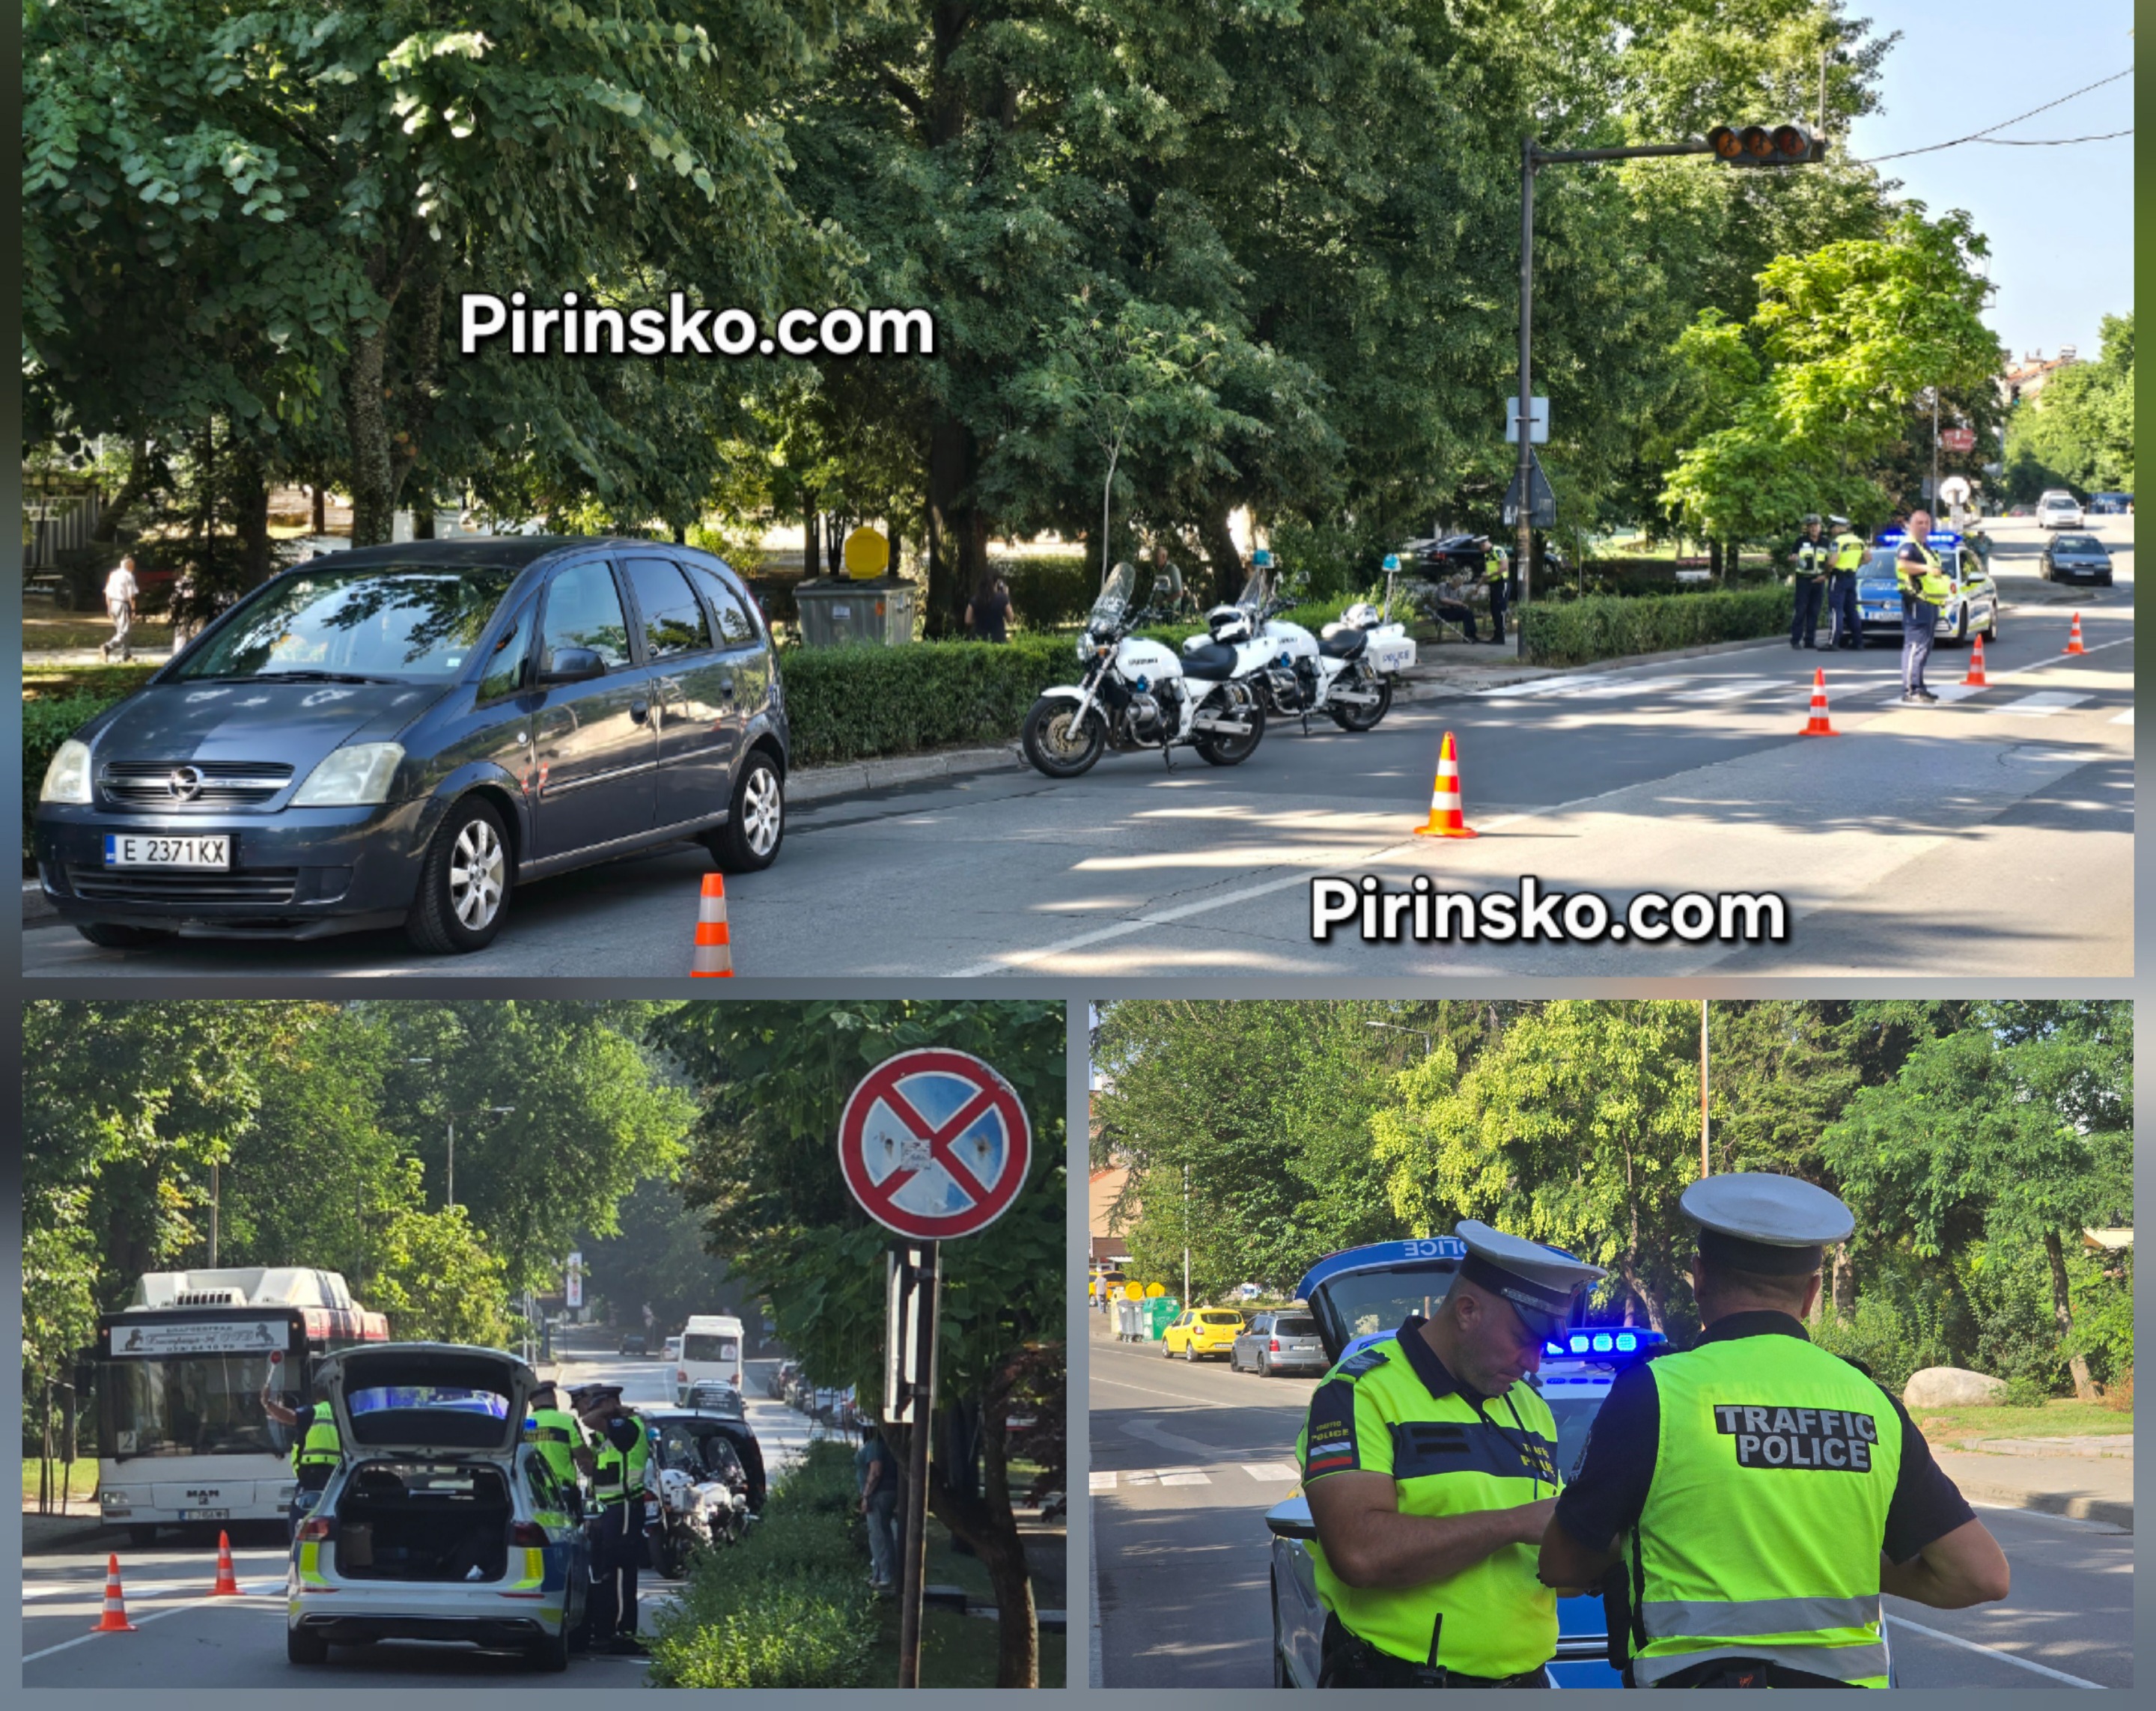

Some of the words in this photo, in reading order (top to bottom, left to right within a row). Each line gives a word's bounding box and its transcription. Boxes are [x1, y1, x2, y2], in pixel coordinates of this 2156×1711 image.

[1716, 1406, 1876, 1441] TRAFFIC
[121, 1432, 133, 1449] 2
[1311, 1428, 1349, 1442] POLICE
[1523, 1443, 1550, 1459] TAFFIC
[1739, 1435, 1869, 1468] POLICE
[187, 1489, 220, 1498] MAN
